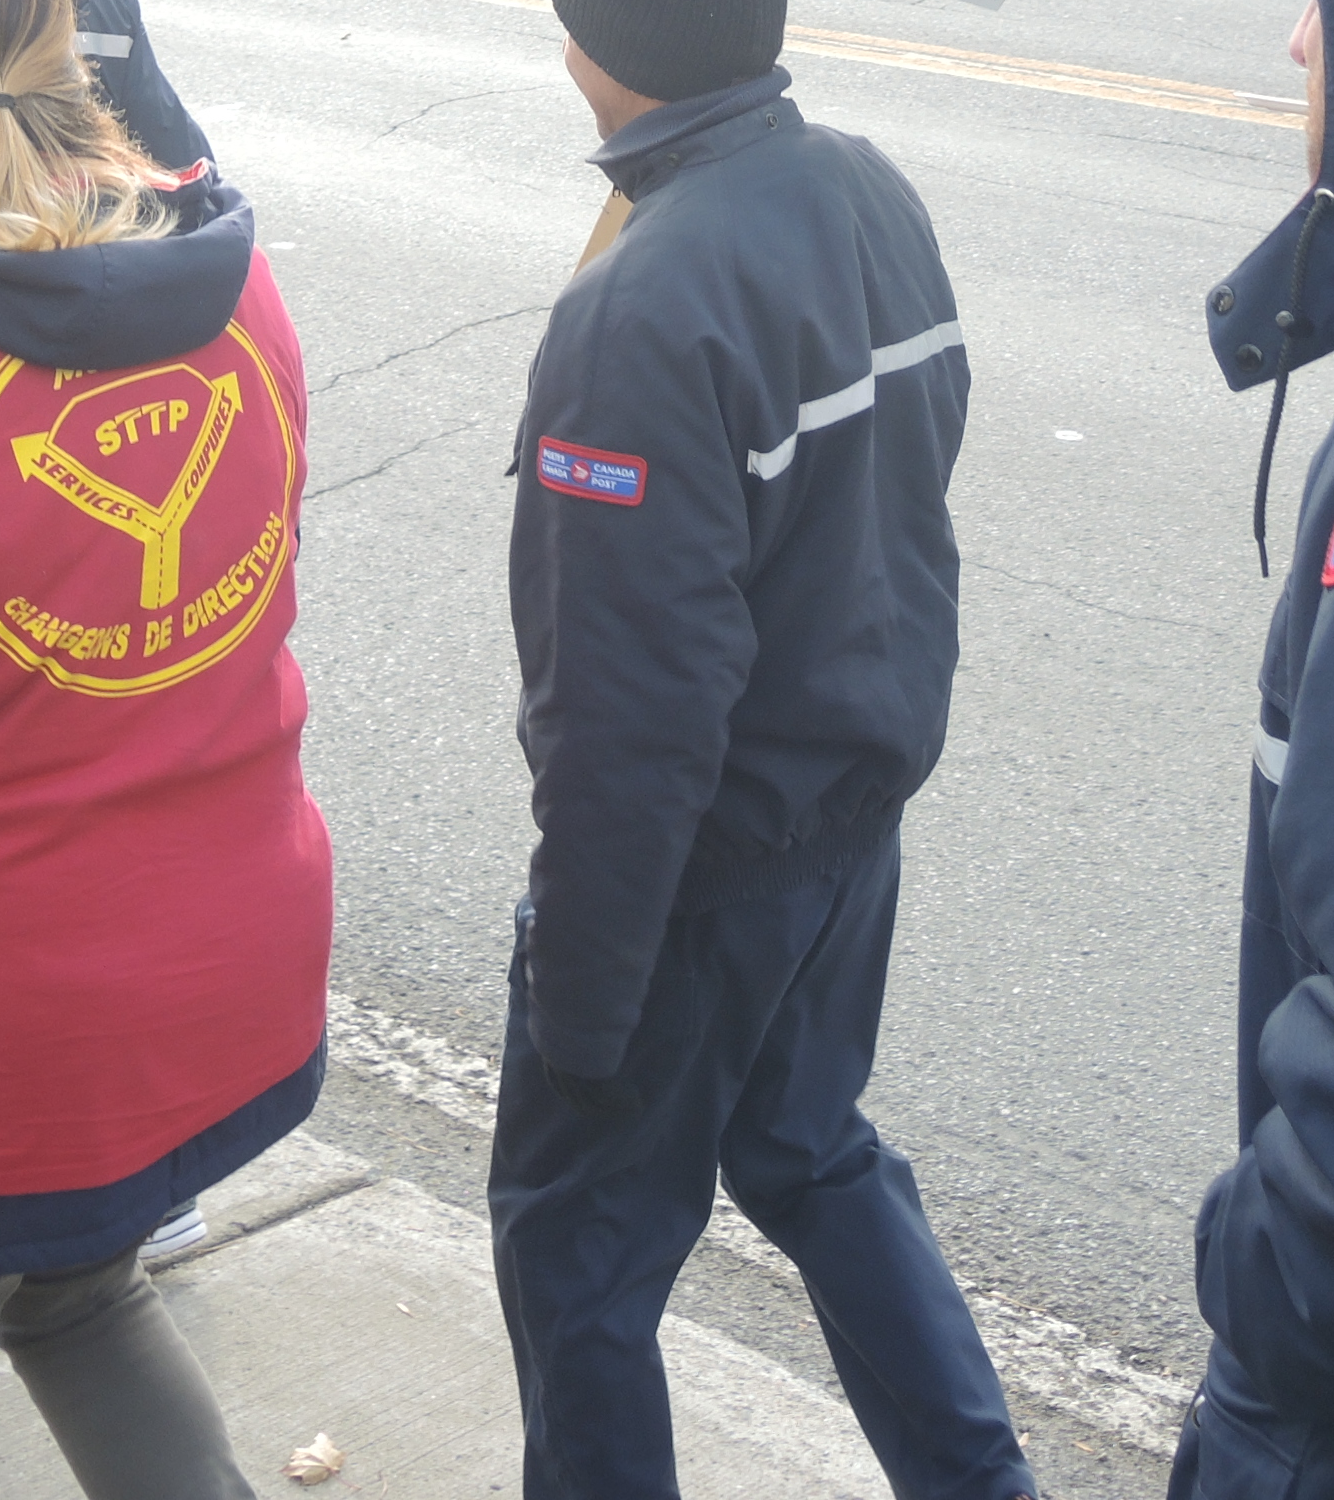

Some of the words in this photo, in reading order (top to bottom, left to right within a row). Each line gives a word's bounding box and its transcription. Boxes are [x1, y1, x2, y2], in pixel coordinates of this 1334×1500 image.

[94, 399, 189, 457] STTP
[182, 386, 233, 500] COUPURES
[31, 452, 138, 522] SERVICES
[590, 476, 617, 491] POST
[593, 462, 636, 479] CANADA
[143, 615, 173, 659] DE
[182, 510, 283, 639] DIRECTION
